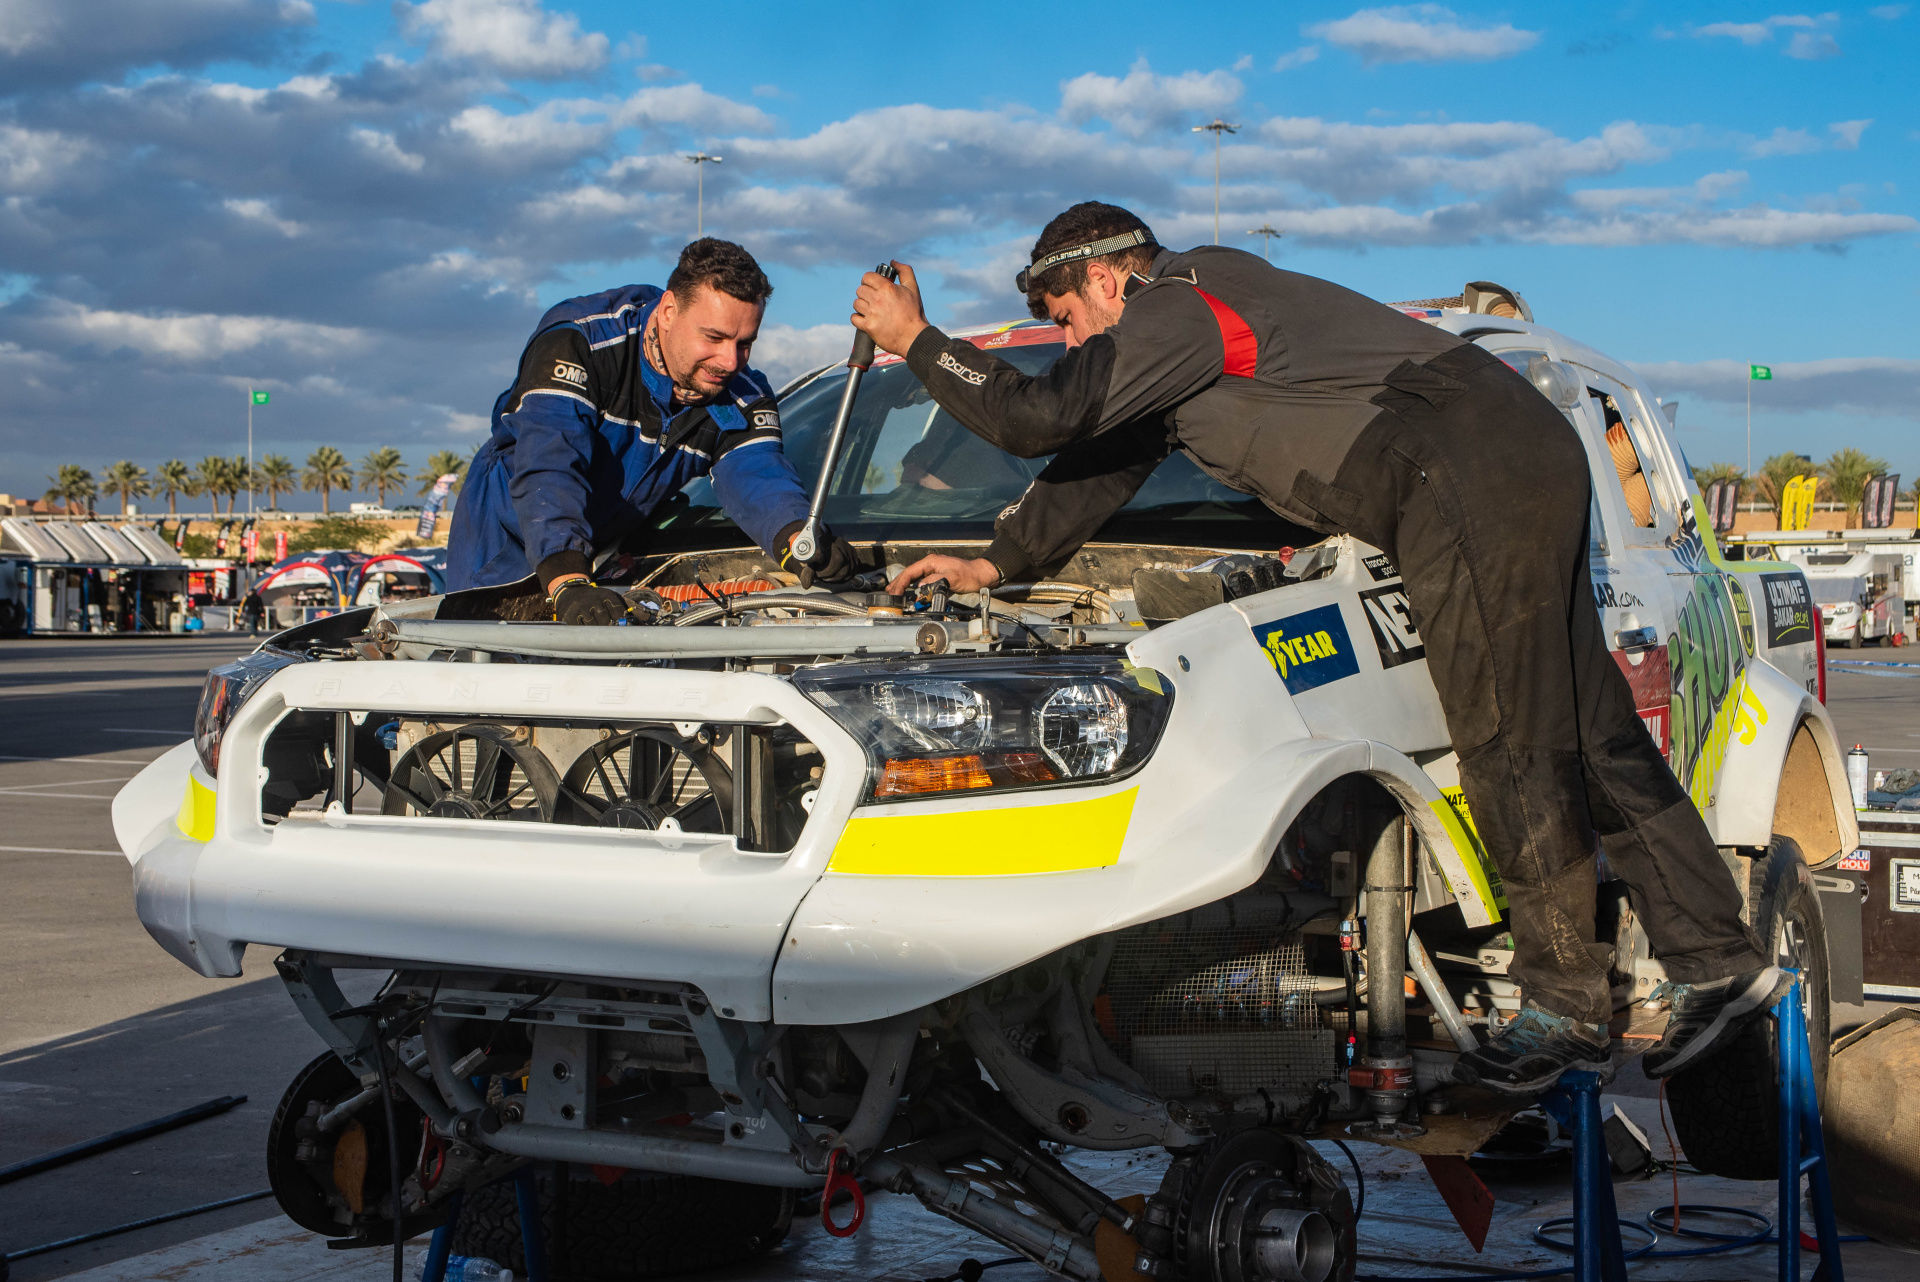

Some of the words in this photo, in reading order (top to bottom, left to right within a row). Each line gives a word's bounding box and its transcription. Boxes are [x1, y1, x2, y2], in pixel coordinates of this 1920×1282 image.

[553, 364, 588, 384] OMP
[1767, 580, 1806, 607] ULTIMATE
[1773, 606, 1795, 628] DAKAR
[1840, 861, 1869, 870] MOLY
